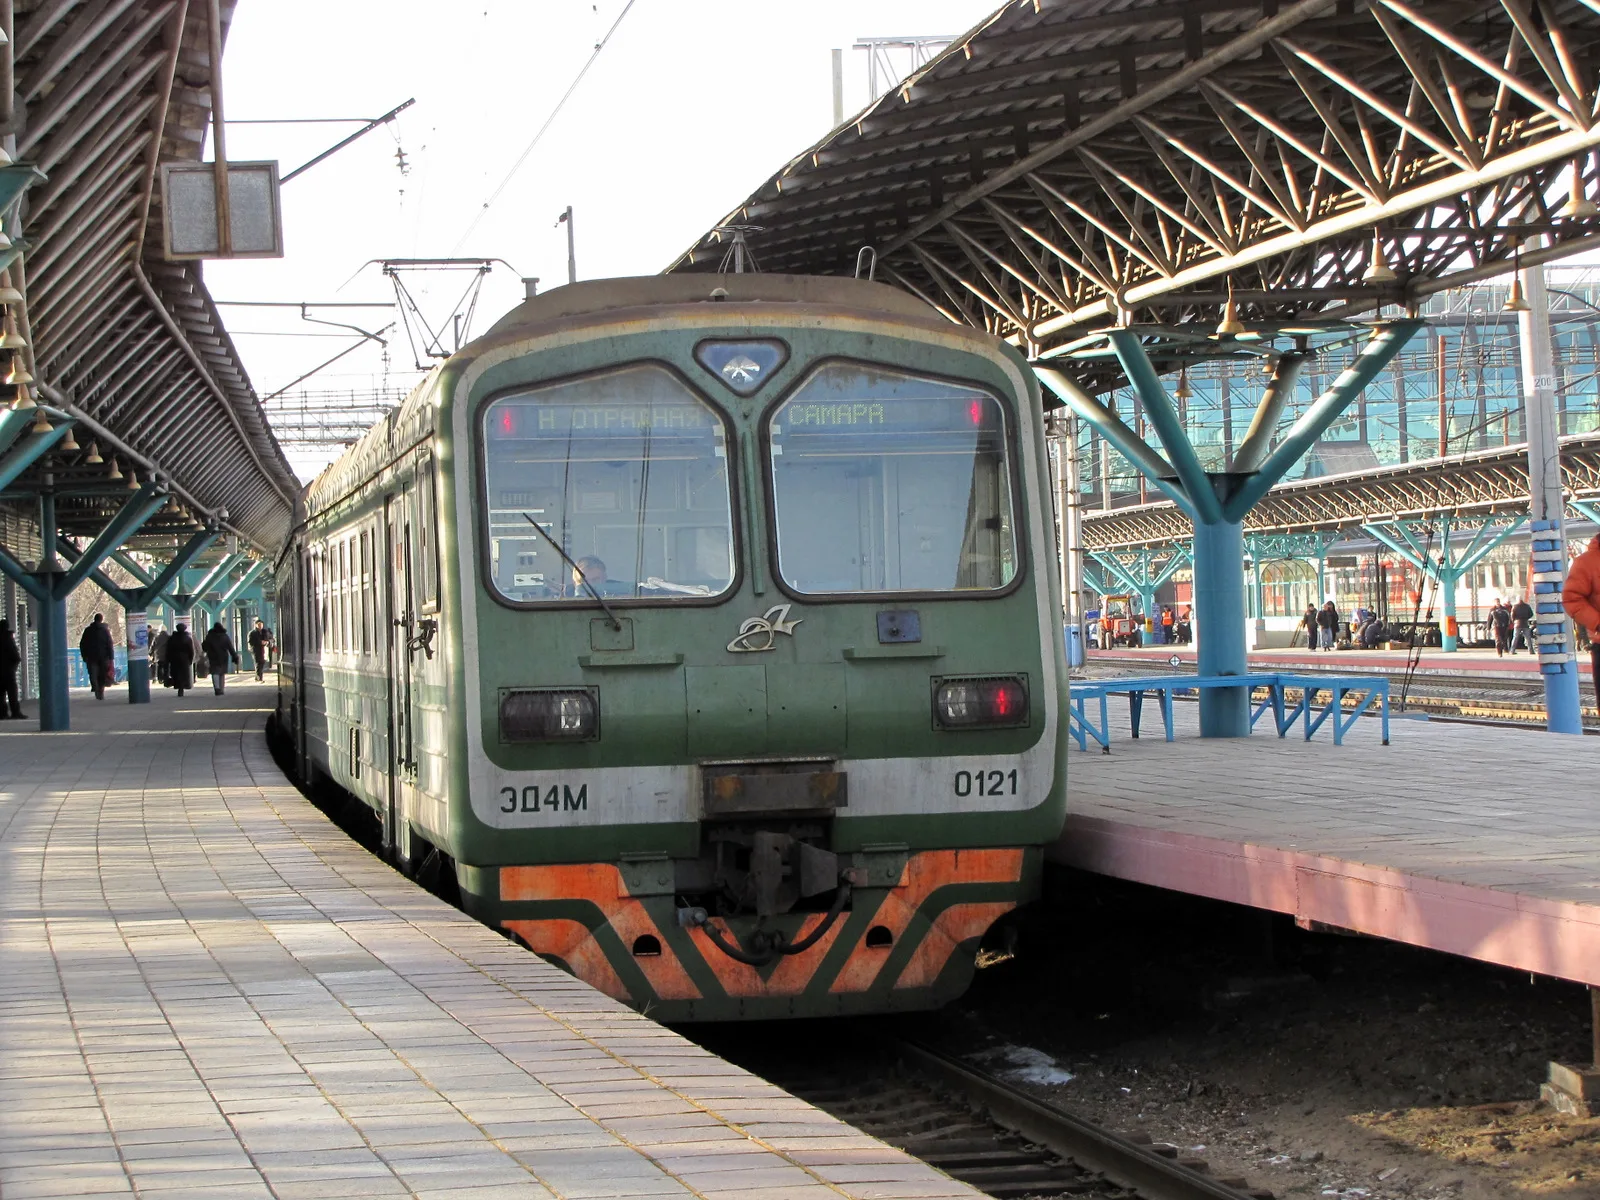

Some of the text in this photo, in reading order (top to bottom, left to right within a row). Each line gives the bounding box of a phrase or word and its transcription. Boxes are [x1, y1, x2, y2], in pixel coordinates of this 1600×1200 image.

[538, 408, 555, 430] Н
[789, 403, 884, 425] САМАРА
[955, 769, 1017, 797] 0121
[500, 784, 588, 813] ЭД4М
